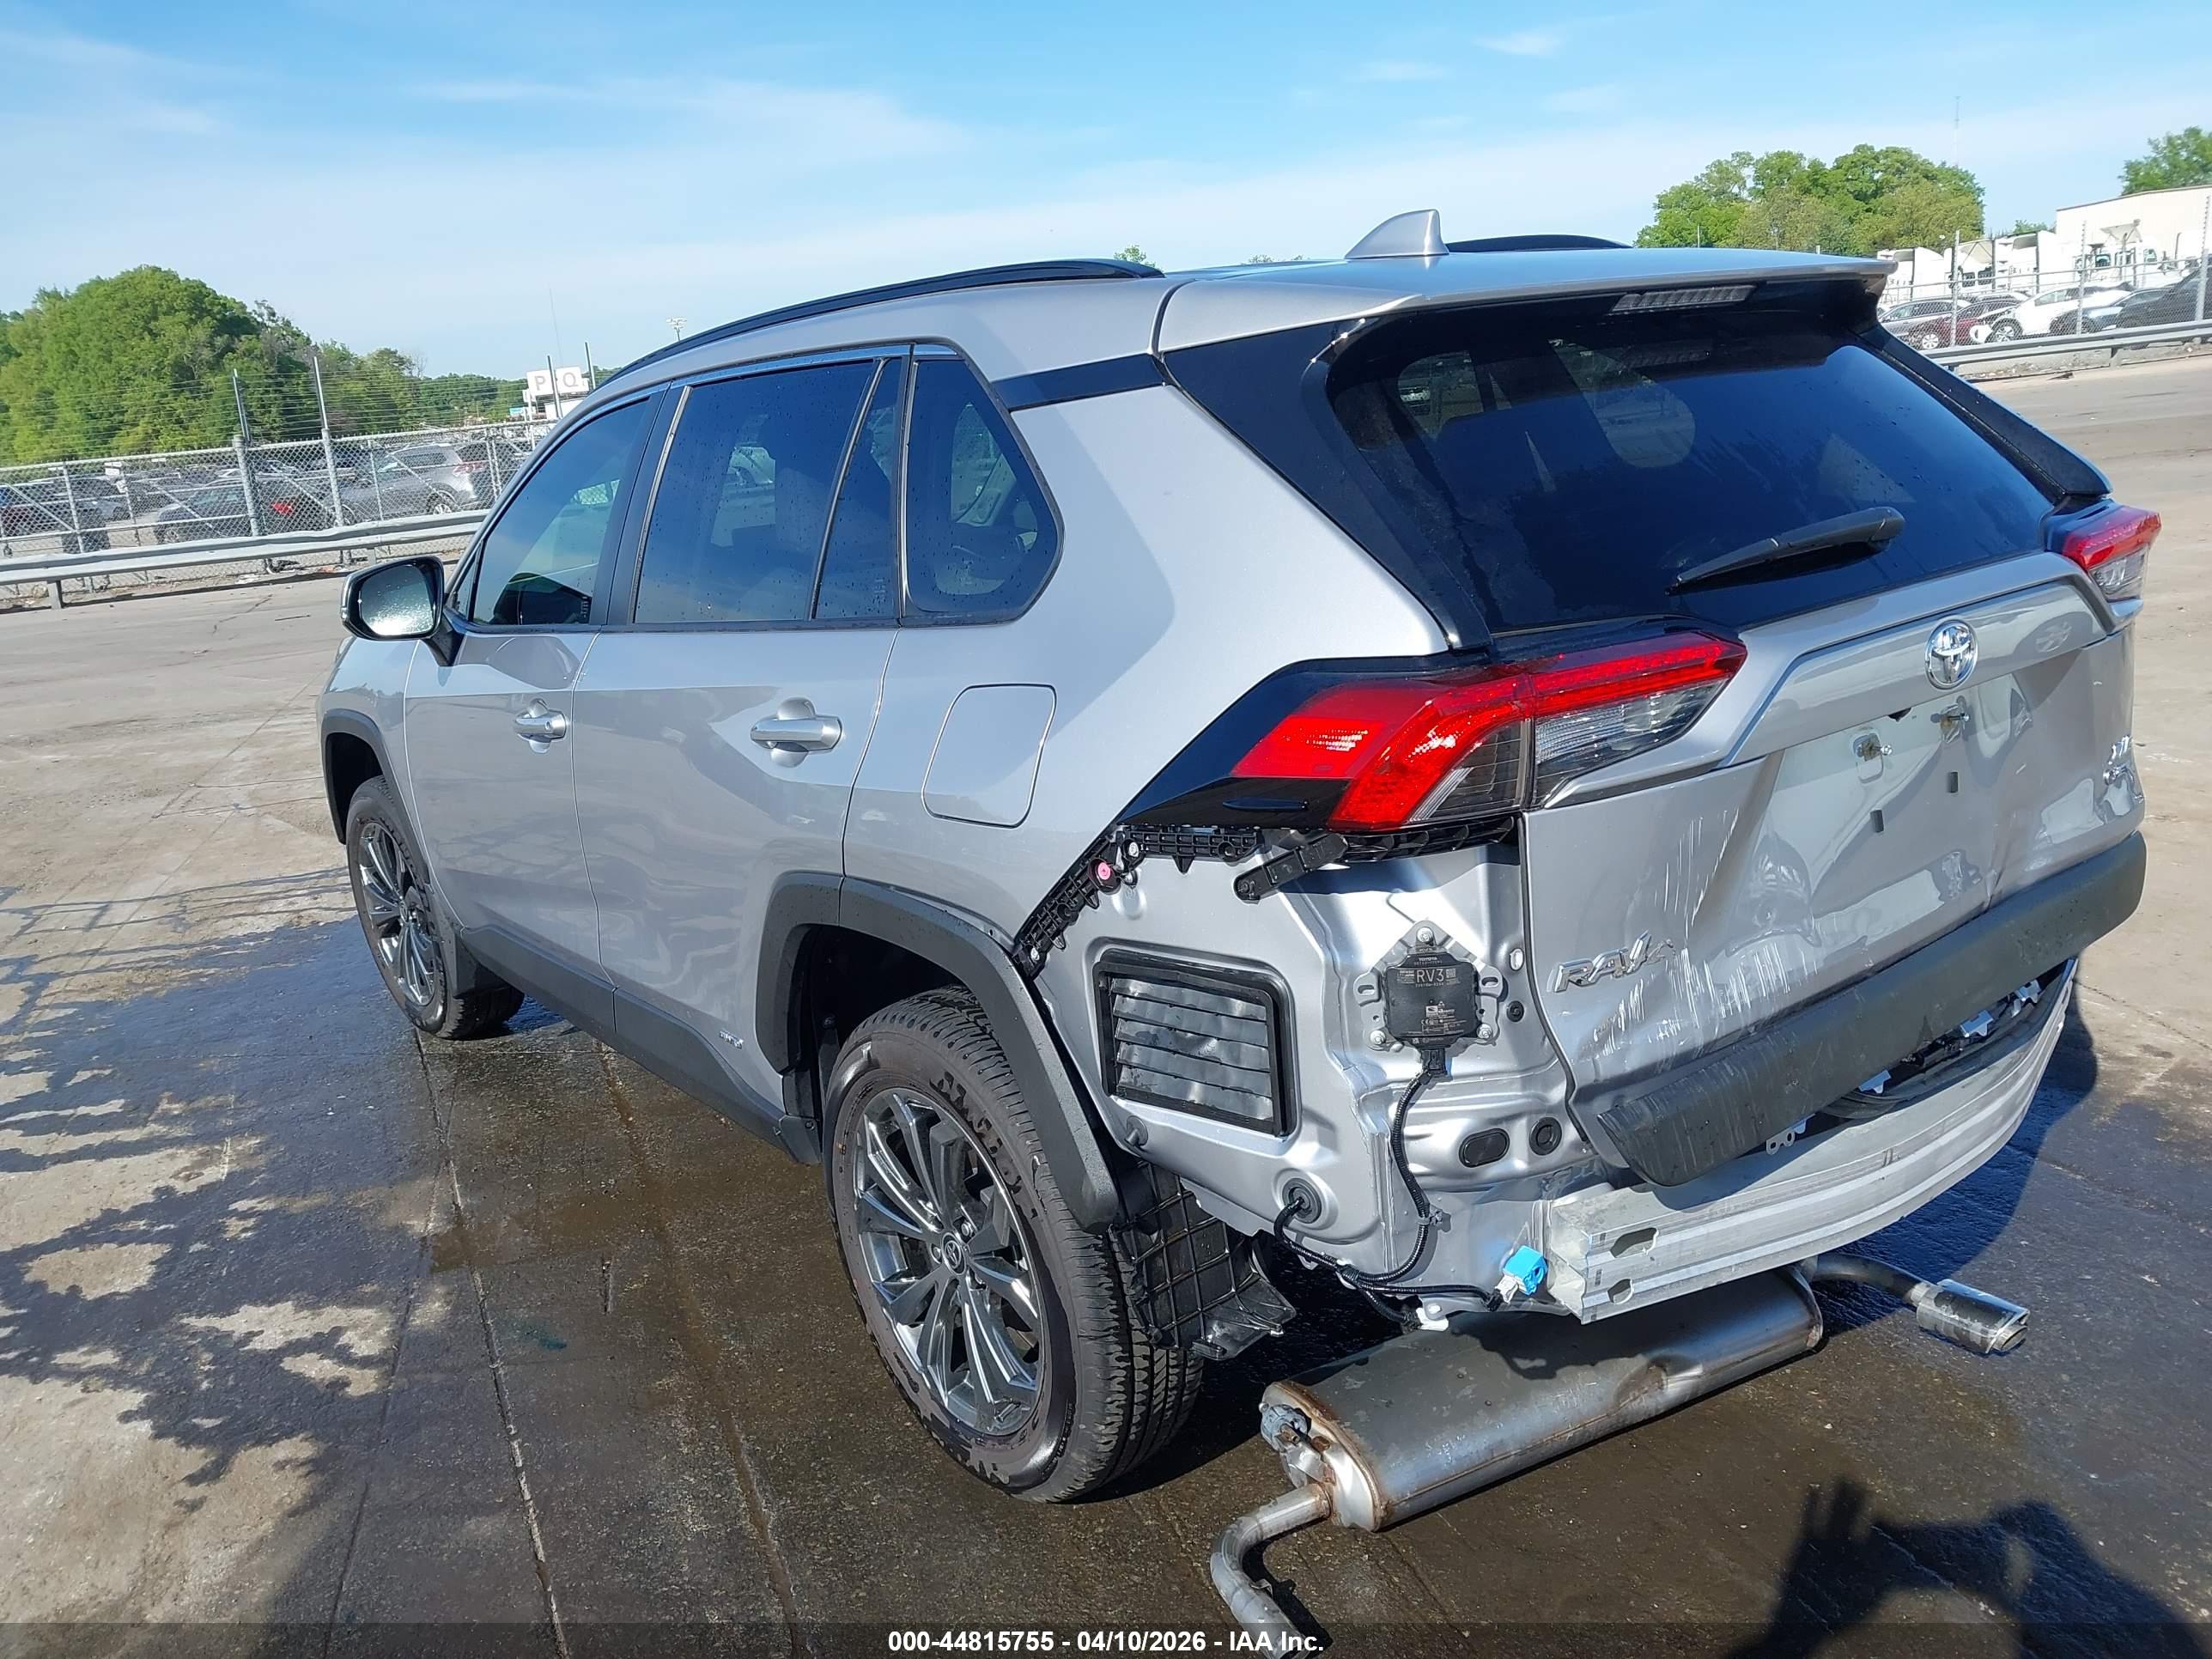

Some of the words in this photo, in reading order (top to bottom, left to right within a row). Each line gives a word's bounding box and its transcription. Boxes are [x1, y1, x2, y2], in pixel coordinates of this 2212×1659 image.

[534, 375, 546, 391] P
[562, 372, 579, 387] Q
[1416, 968, 1444, 983] RV3
